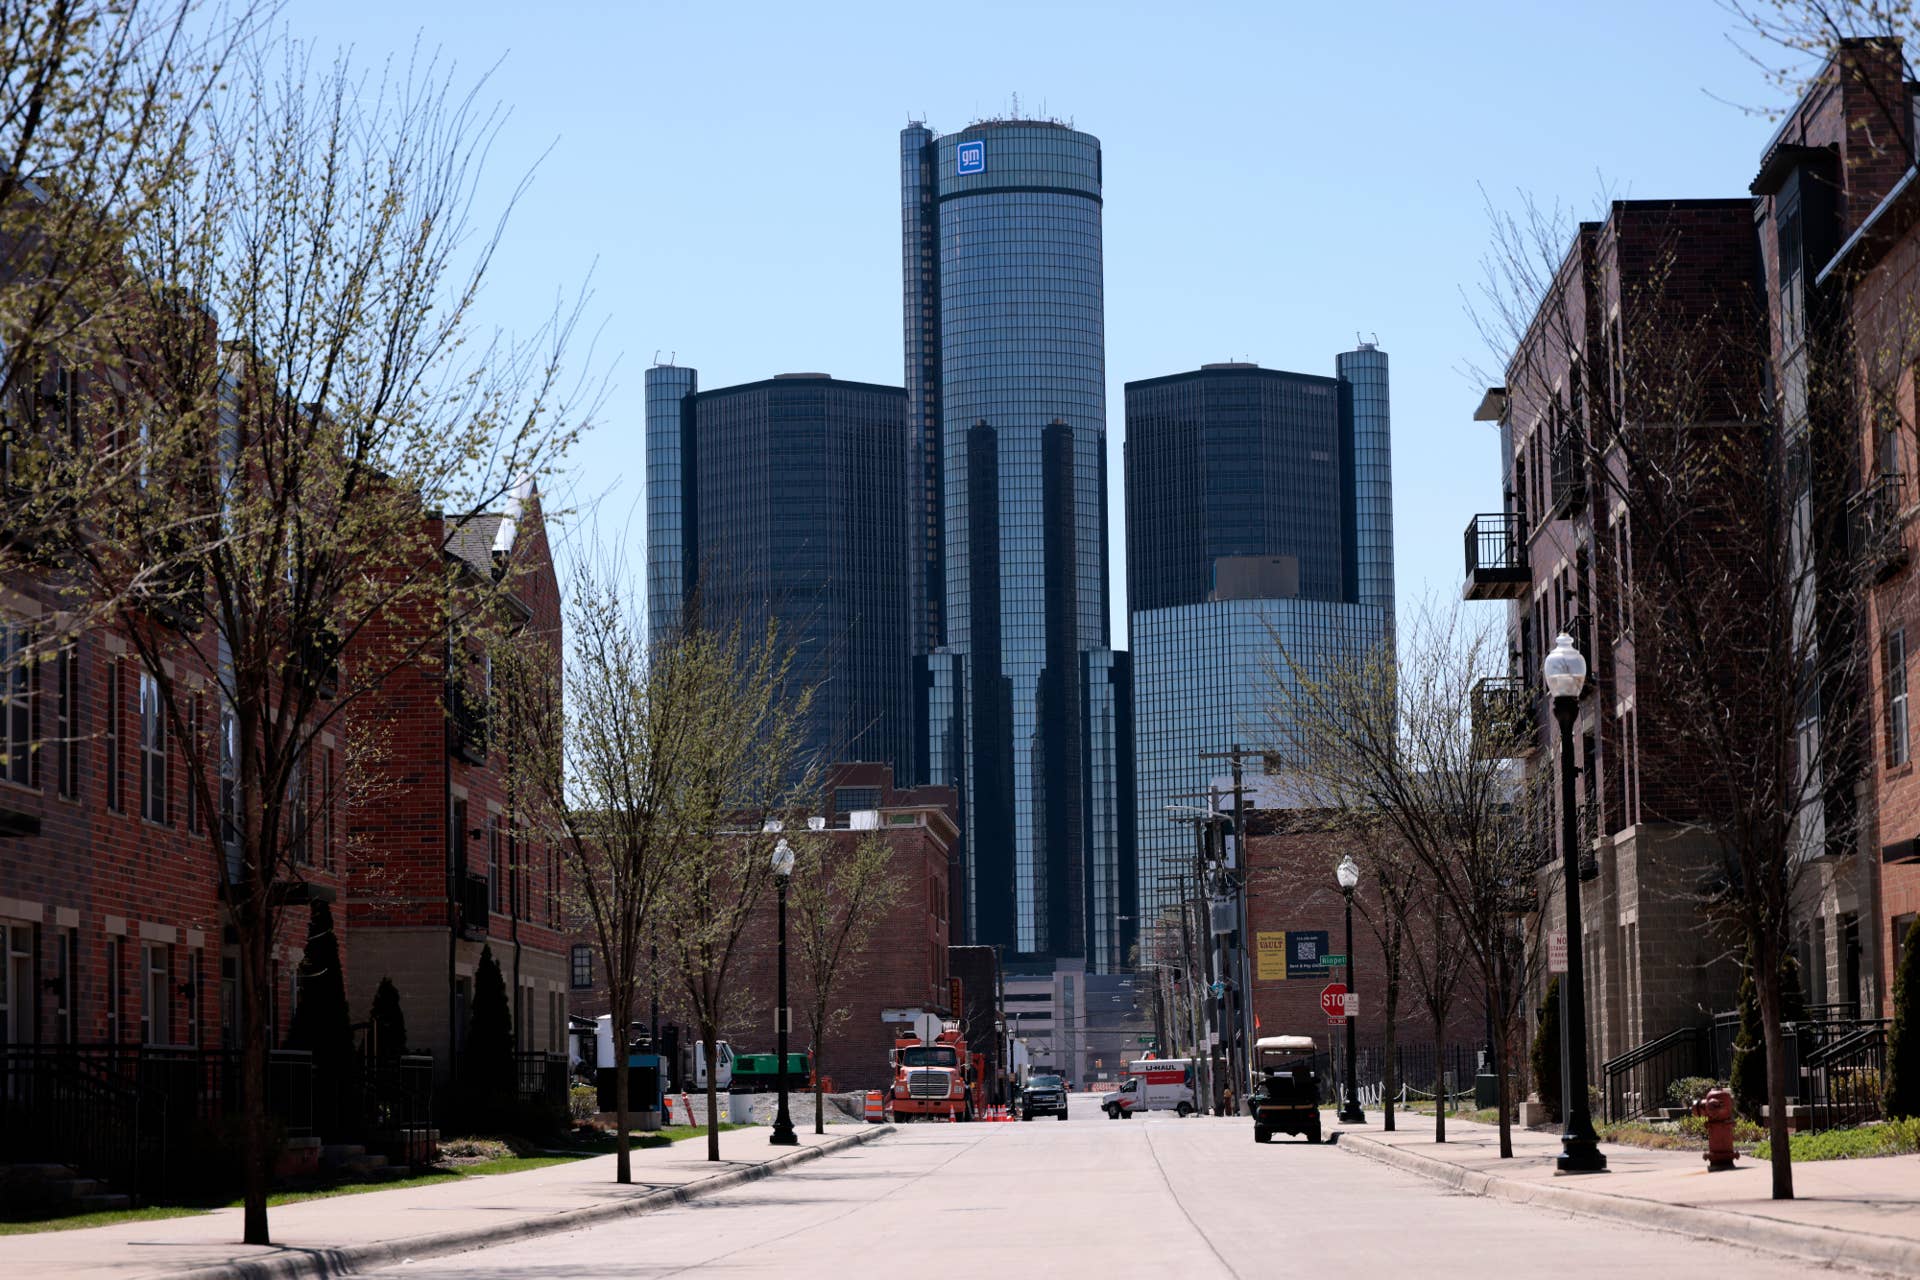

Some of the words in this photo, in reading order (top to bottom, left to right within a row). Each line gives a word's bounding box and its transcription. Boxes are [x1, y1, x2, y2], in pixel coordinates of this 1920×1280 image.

[962, 149, 979, 166] gm
[1322, 957, 1345, 965] Riopel
[1323, 994, 1345, 1007] STO
